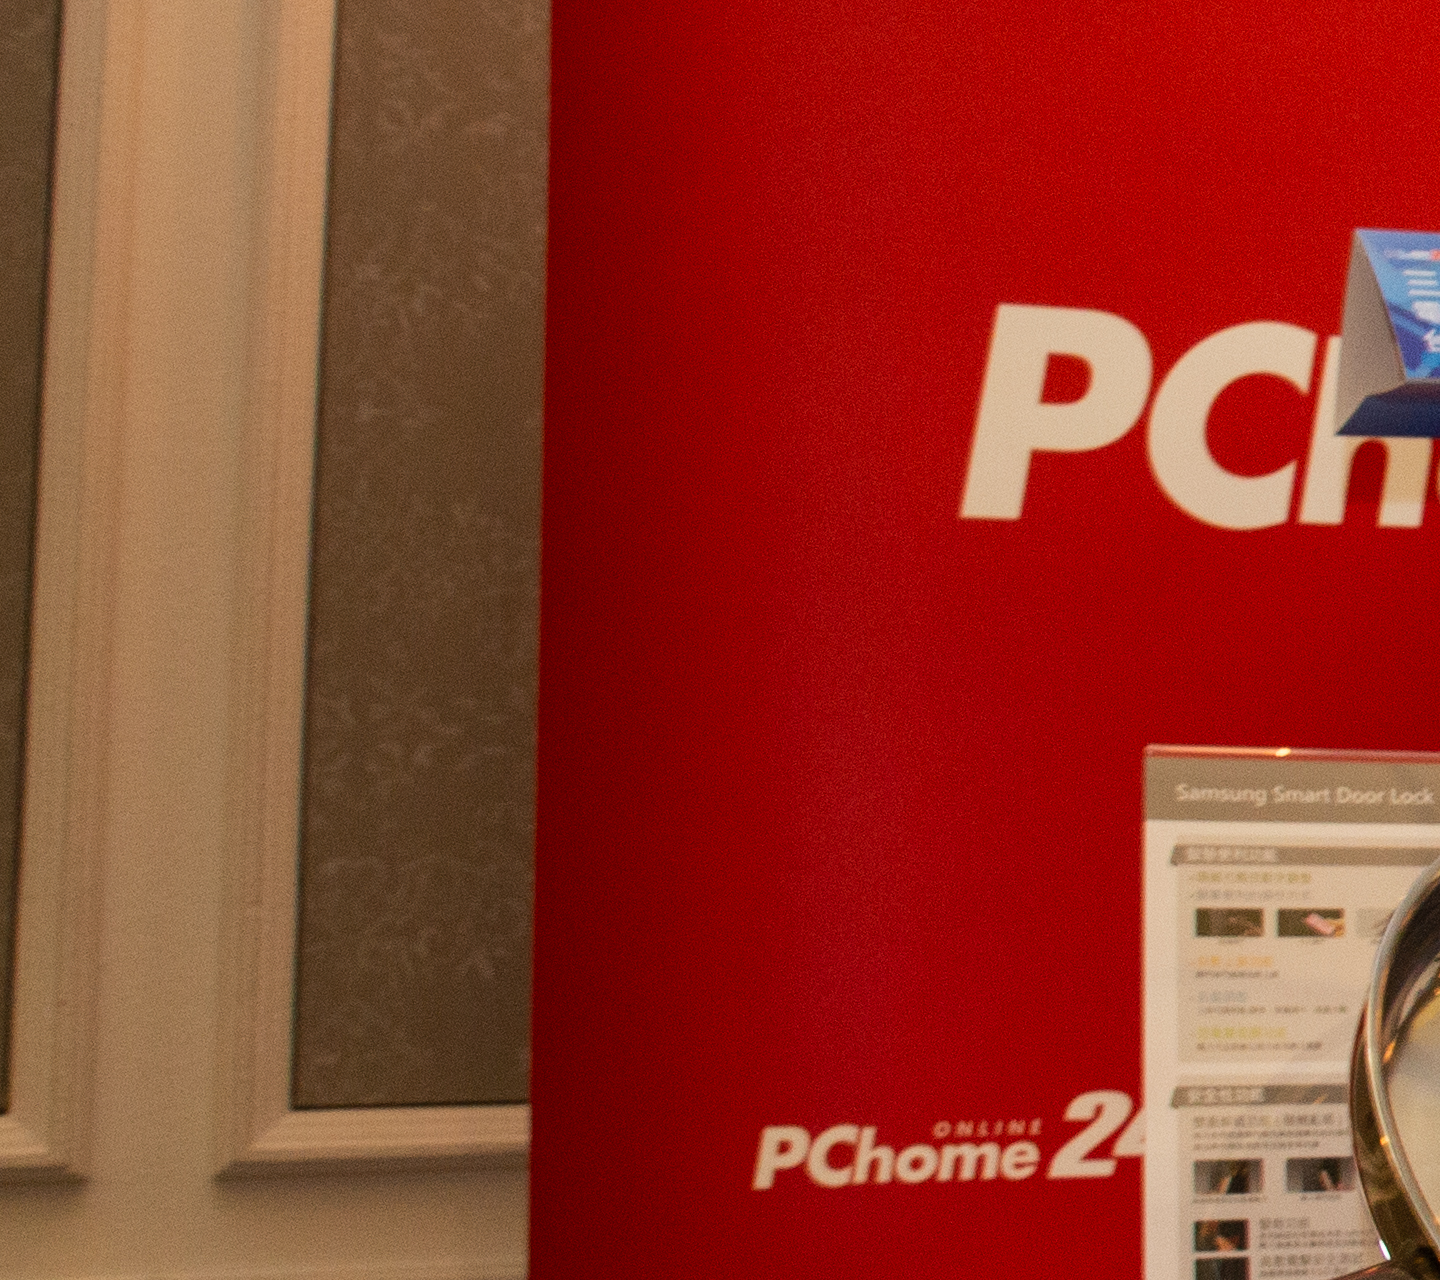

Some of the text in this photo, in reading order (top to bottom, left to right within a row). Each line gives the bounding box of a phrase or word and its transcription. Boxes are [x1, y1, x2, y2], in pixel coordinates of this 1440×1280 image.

[1175, 782, 1268, 807] Samsung
[1272, 784, 1331, 805] Smart
[1336, 786, 1386, 806] Door
[1389, 786, 1435, 806] Lock
[932, 1118, 1042, 1138] ONLINE
[752, 1123, 1041, 1190] PChome
